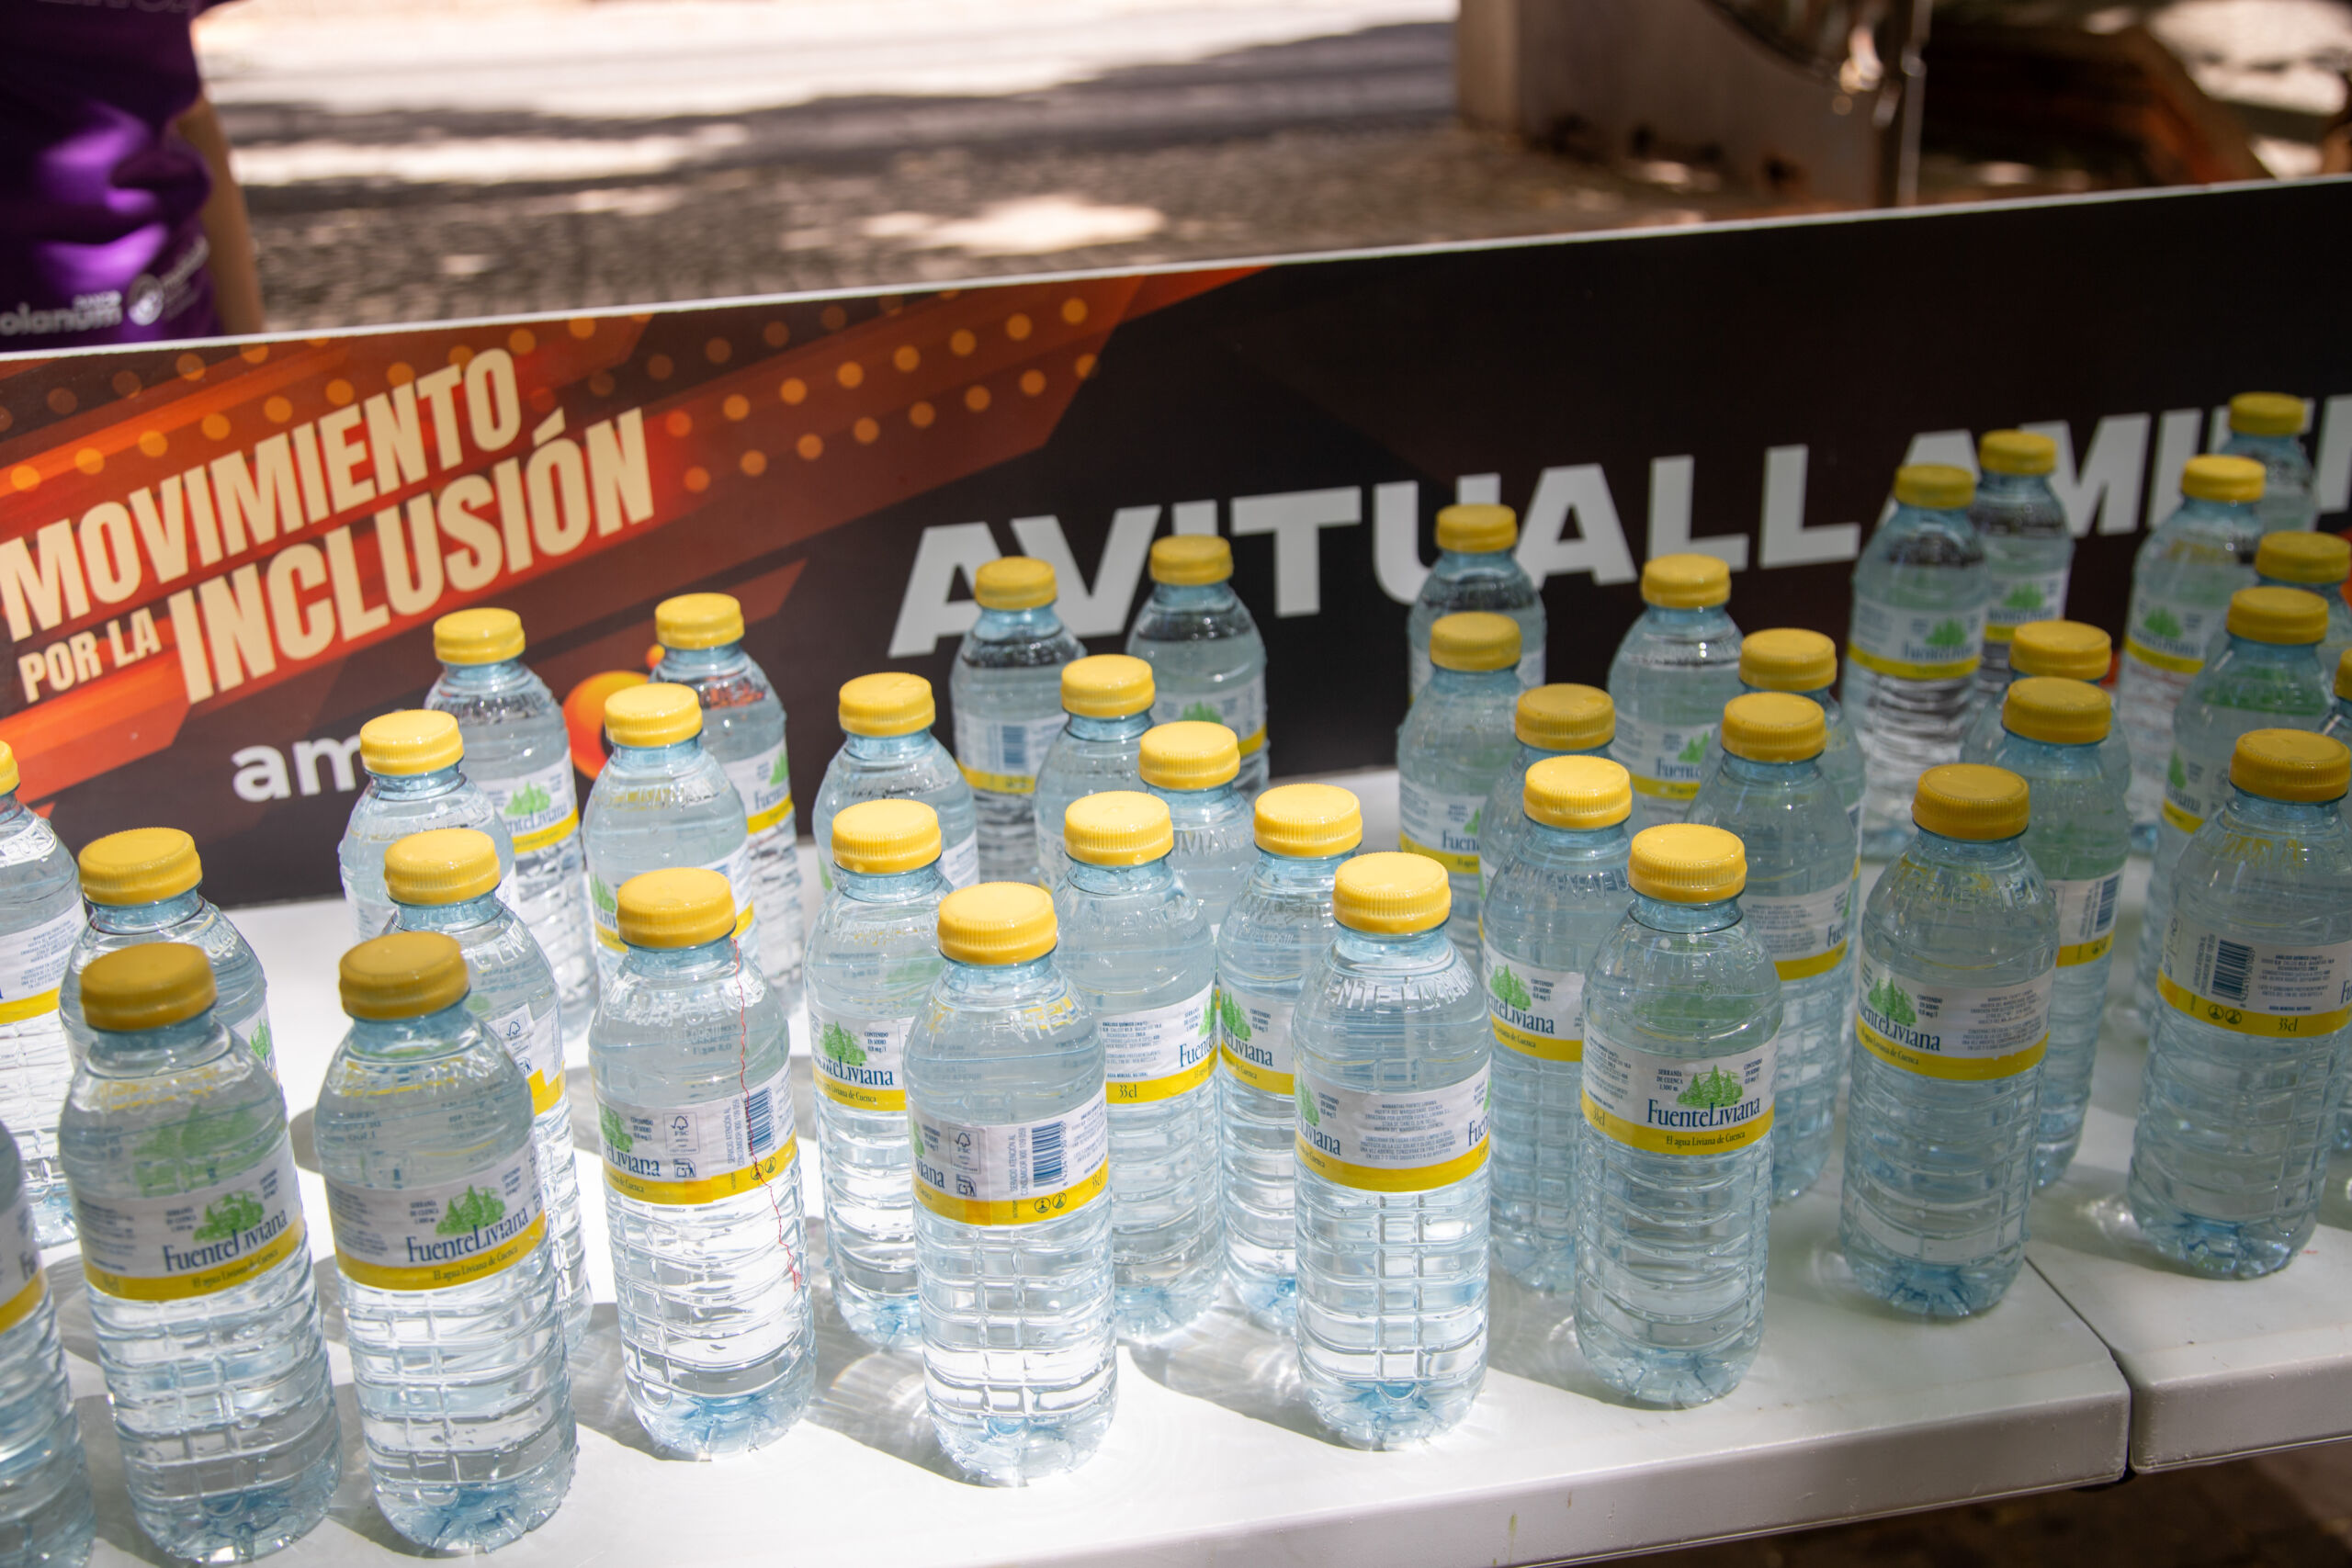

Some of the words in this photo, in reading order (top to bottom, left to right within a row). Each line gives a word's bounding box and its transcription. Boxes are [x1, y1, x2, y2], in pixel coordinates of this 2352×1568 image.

[0, 348, 522, 642] MOVIMIENTO
[168, 407, 654, 705] INCLUSIÓN
[17, 632, 102, 705] POR
[107, 606, 162, 668] LA
[1647, 1097, 1760, 1127] FuenteLiviana
[1666, 1134, 1673, 1145] El
[1674, 1138, 1690, 1149] agua
[1692, 1135, 1716, 1146] Liviana
[1717, 1134, 1724, 1145] de
[1725, 1130, 1746, 1144] Cuenca
[162, 1209, 288, 1272] FuenteLiviana
[406, 1206, 529, 1263] FuenteLiviana
[434, 1270, 442, 1280] El
[443, 1268, 460, 1282] agua
[460, 1262, 488, 1276] Liviana
[488, 1256, 496, 1266] de
[496, 1246, 518, 1262] Cuenca
